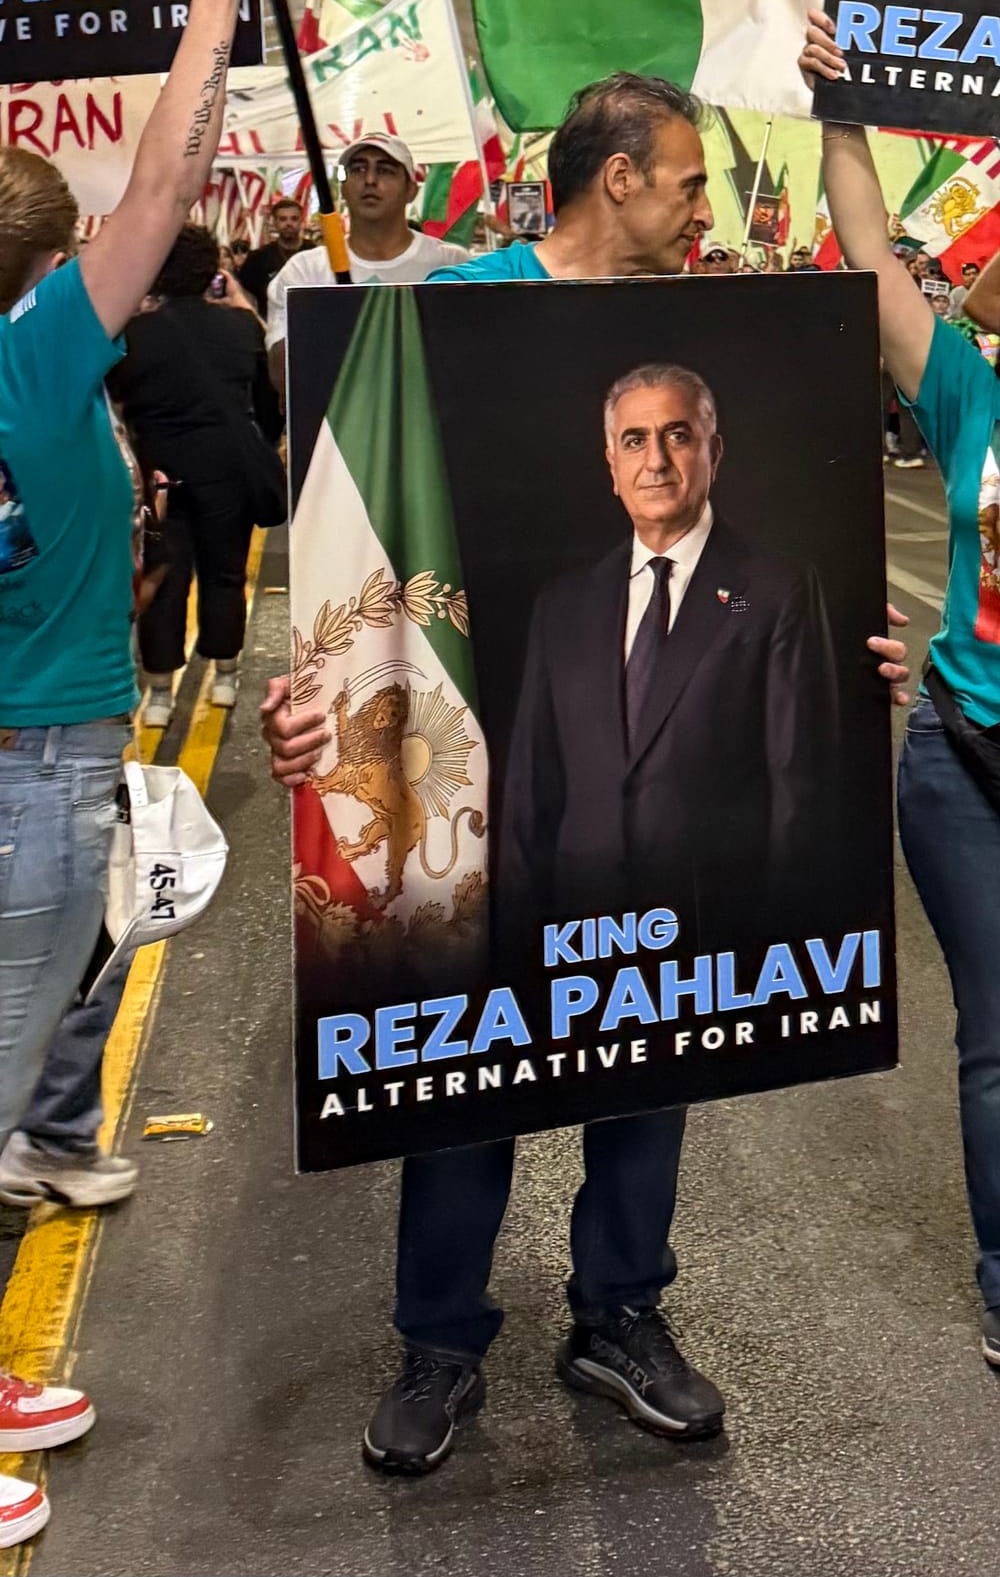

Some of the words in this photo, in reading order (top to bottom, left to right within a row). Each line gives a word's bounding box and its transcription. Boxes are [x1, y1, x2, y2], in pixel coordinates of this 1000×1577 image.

[56, 10, 128, 37] FOR
[0, 92, 123, 158] RAN
[150, 863, 177, 921] 45-47
[543, 907, 679, 969] KING
[317, 986, 531, 1081] REZA
[550, 929, 882, 1040] PAHLAVI
[319, 1039, 649, 1120] ALTERNATIVE
[674, 1019, 756, 1056] FOR
[781, 999, 882, 1039] IRAN
